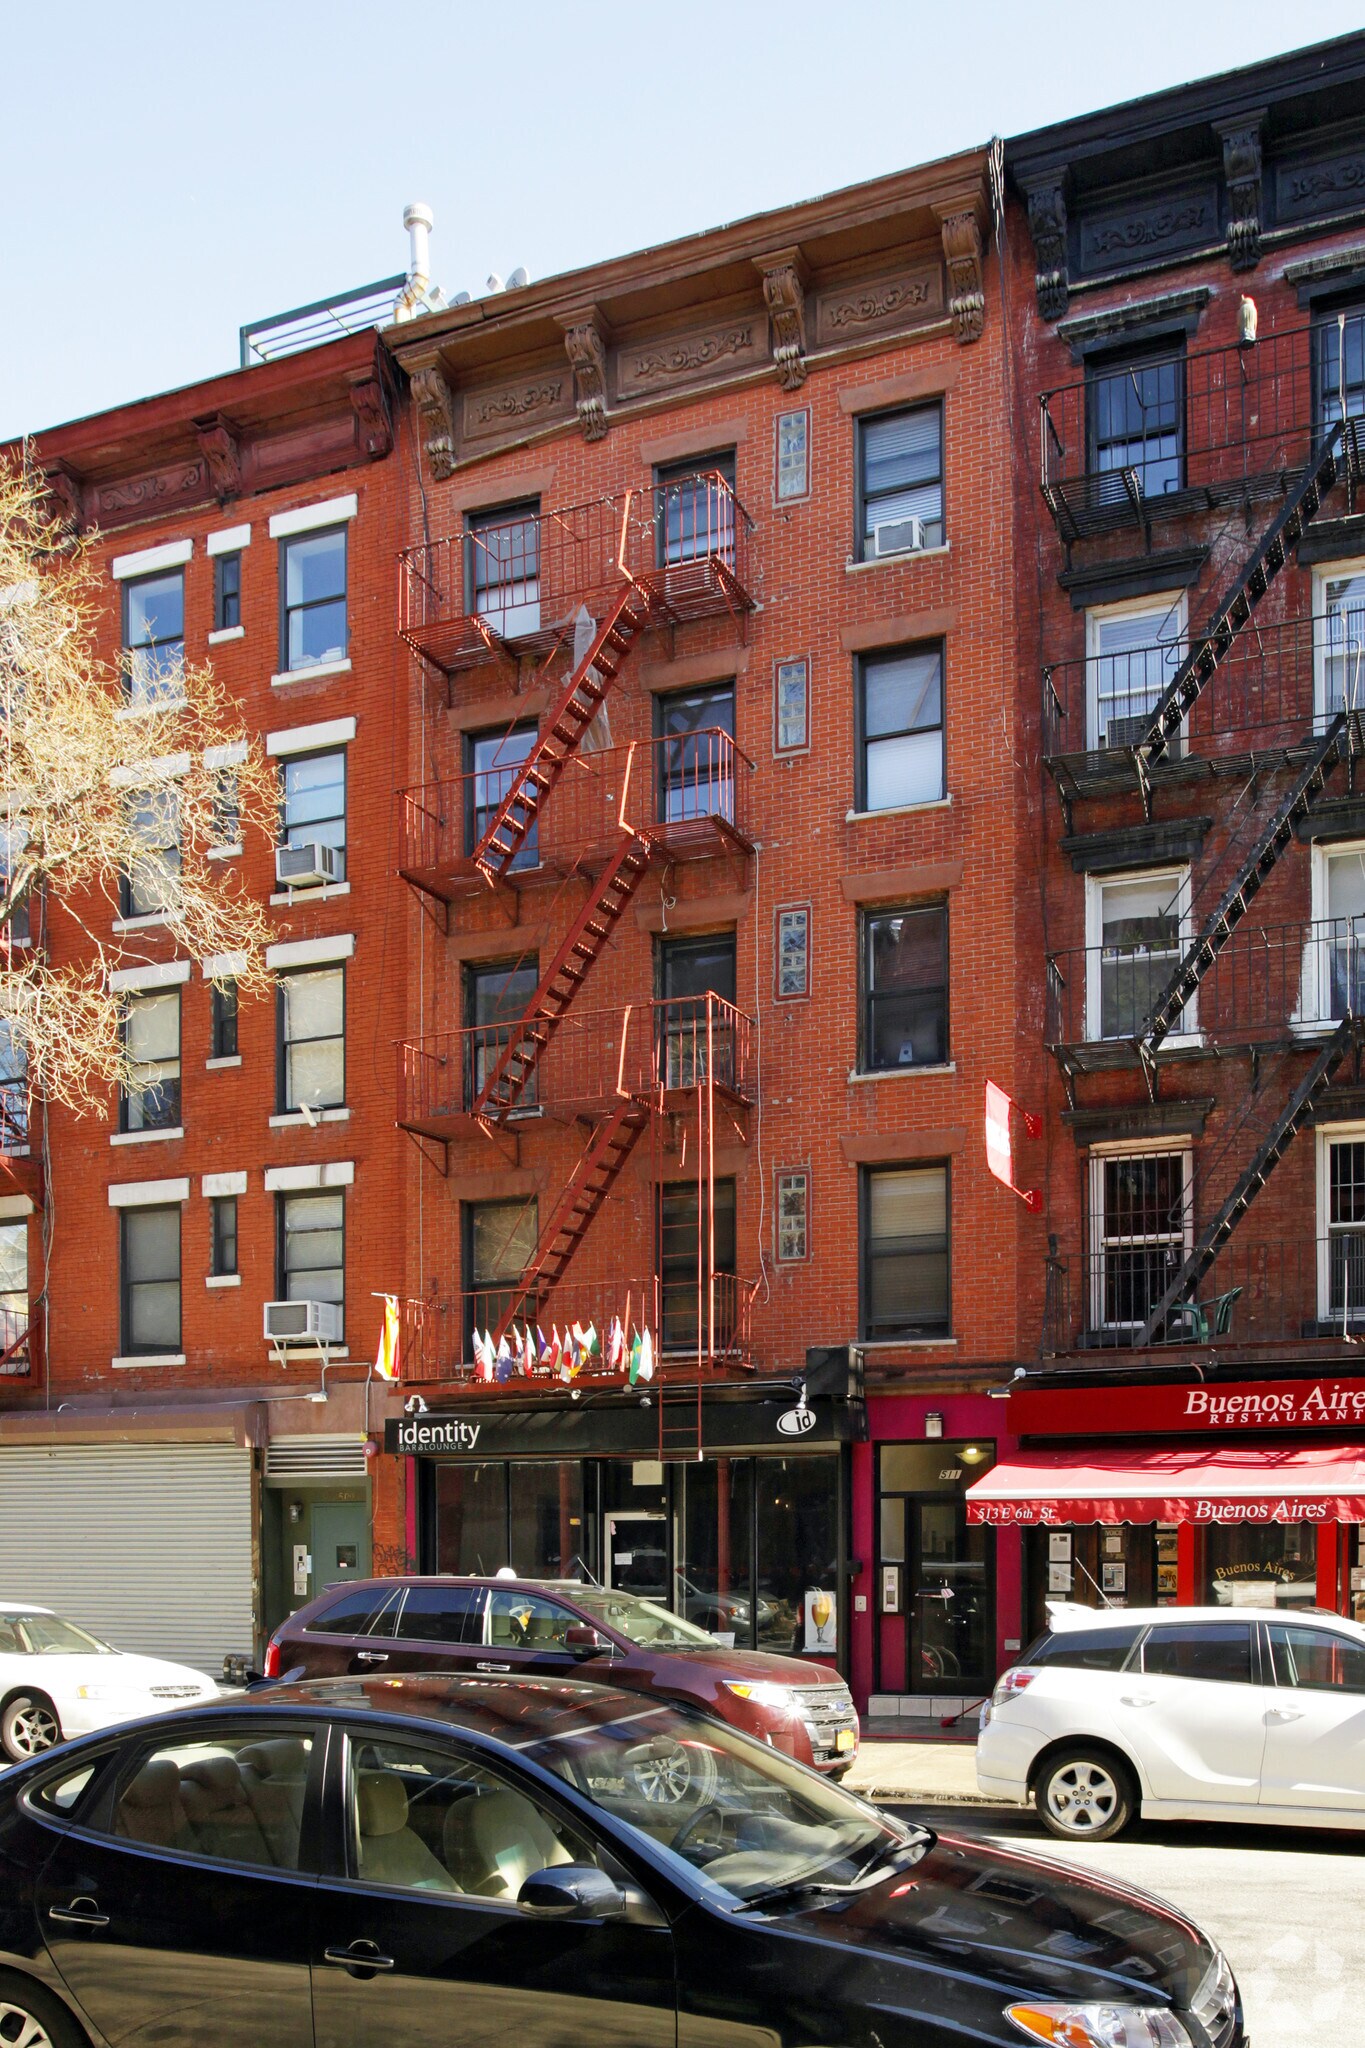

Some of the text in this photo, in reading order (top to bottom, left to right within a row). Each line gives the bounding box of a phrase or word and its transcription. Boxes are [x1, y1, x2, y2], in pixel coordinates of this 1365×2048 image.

[1183, 1391, 1295, 1415] Buenos
[1209, 1409, 1364, 1424] RESTAURANT
[398, 1420, 481, 1449] identity
[940, 1470, 960, 1479] 511
[977, 1506, 1056, 1519] 513 E 6th St.
[1195, 1499, 1327, 1519] Buenos Aires
[1215, 1561, 1296, 1581] Buenos Aires
